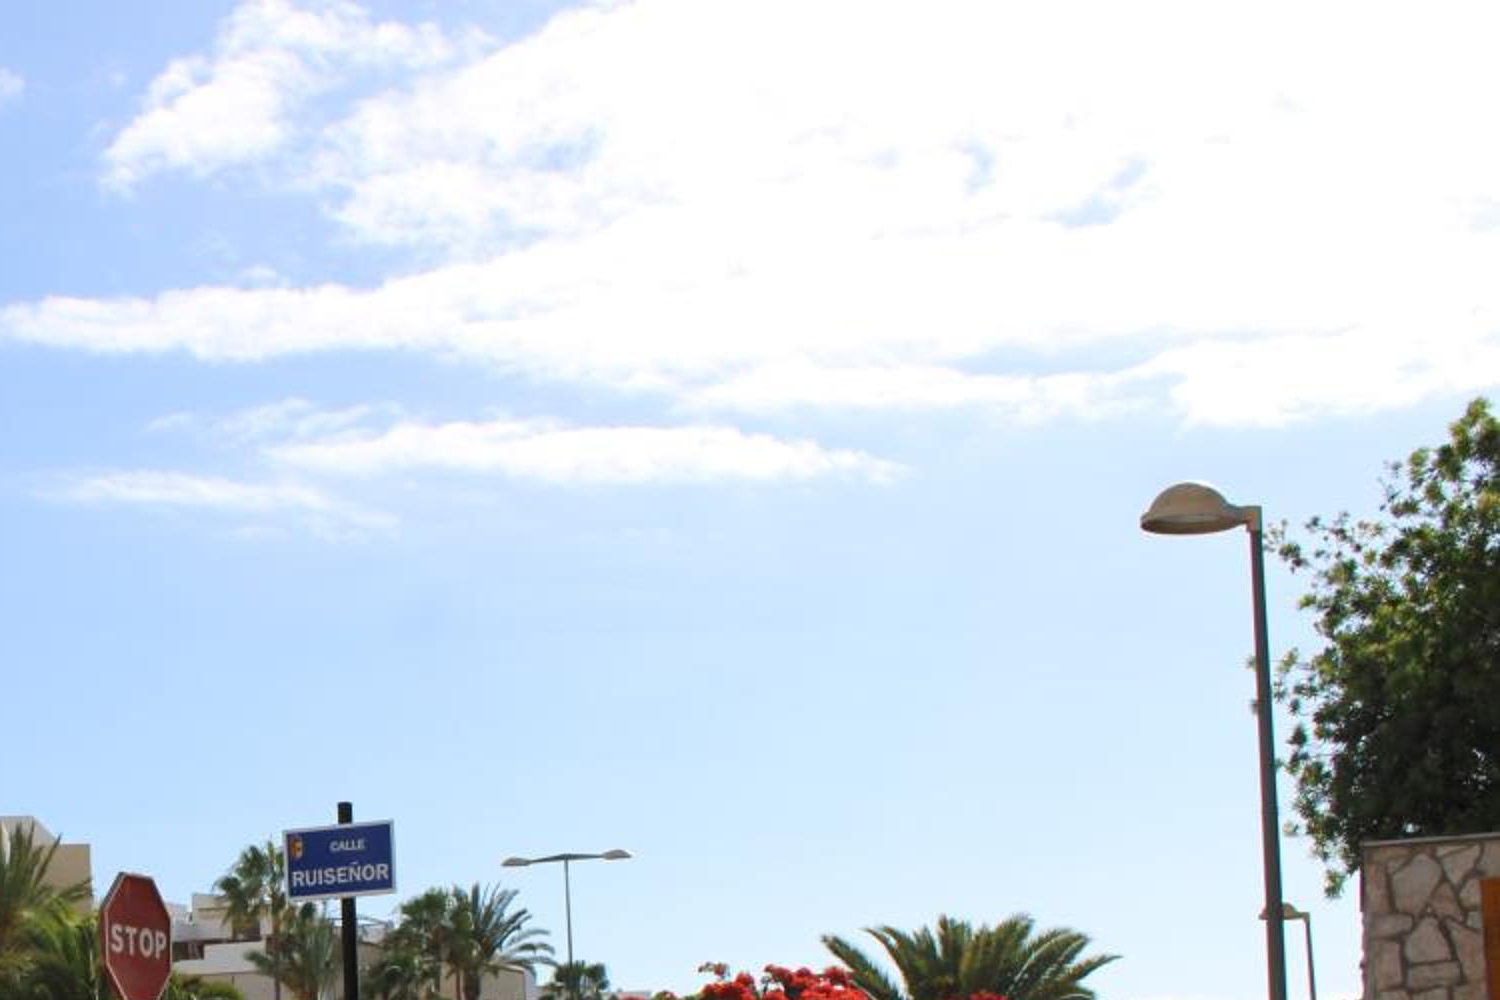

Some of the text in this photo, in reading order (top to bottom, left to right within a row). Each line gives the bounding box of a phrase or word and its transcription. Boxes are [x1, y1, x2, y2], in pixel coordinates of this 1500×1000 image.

[329, 838, 365, 852] CALLE
[292, 861, 389, 887] RUISEÑOR
[110, 923, 167, 959] STOP
